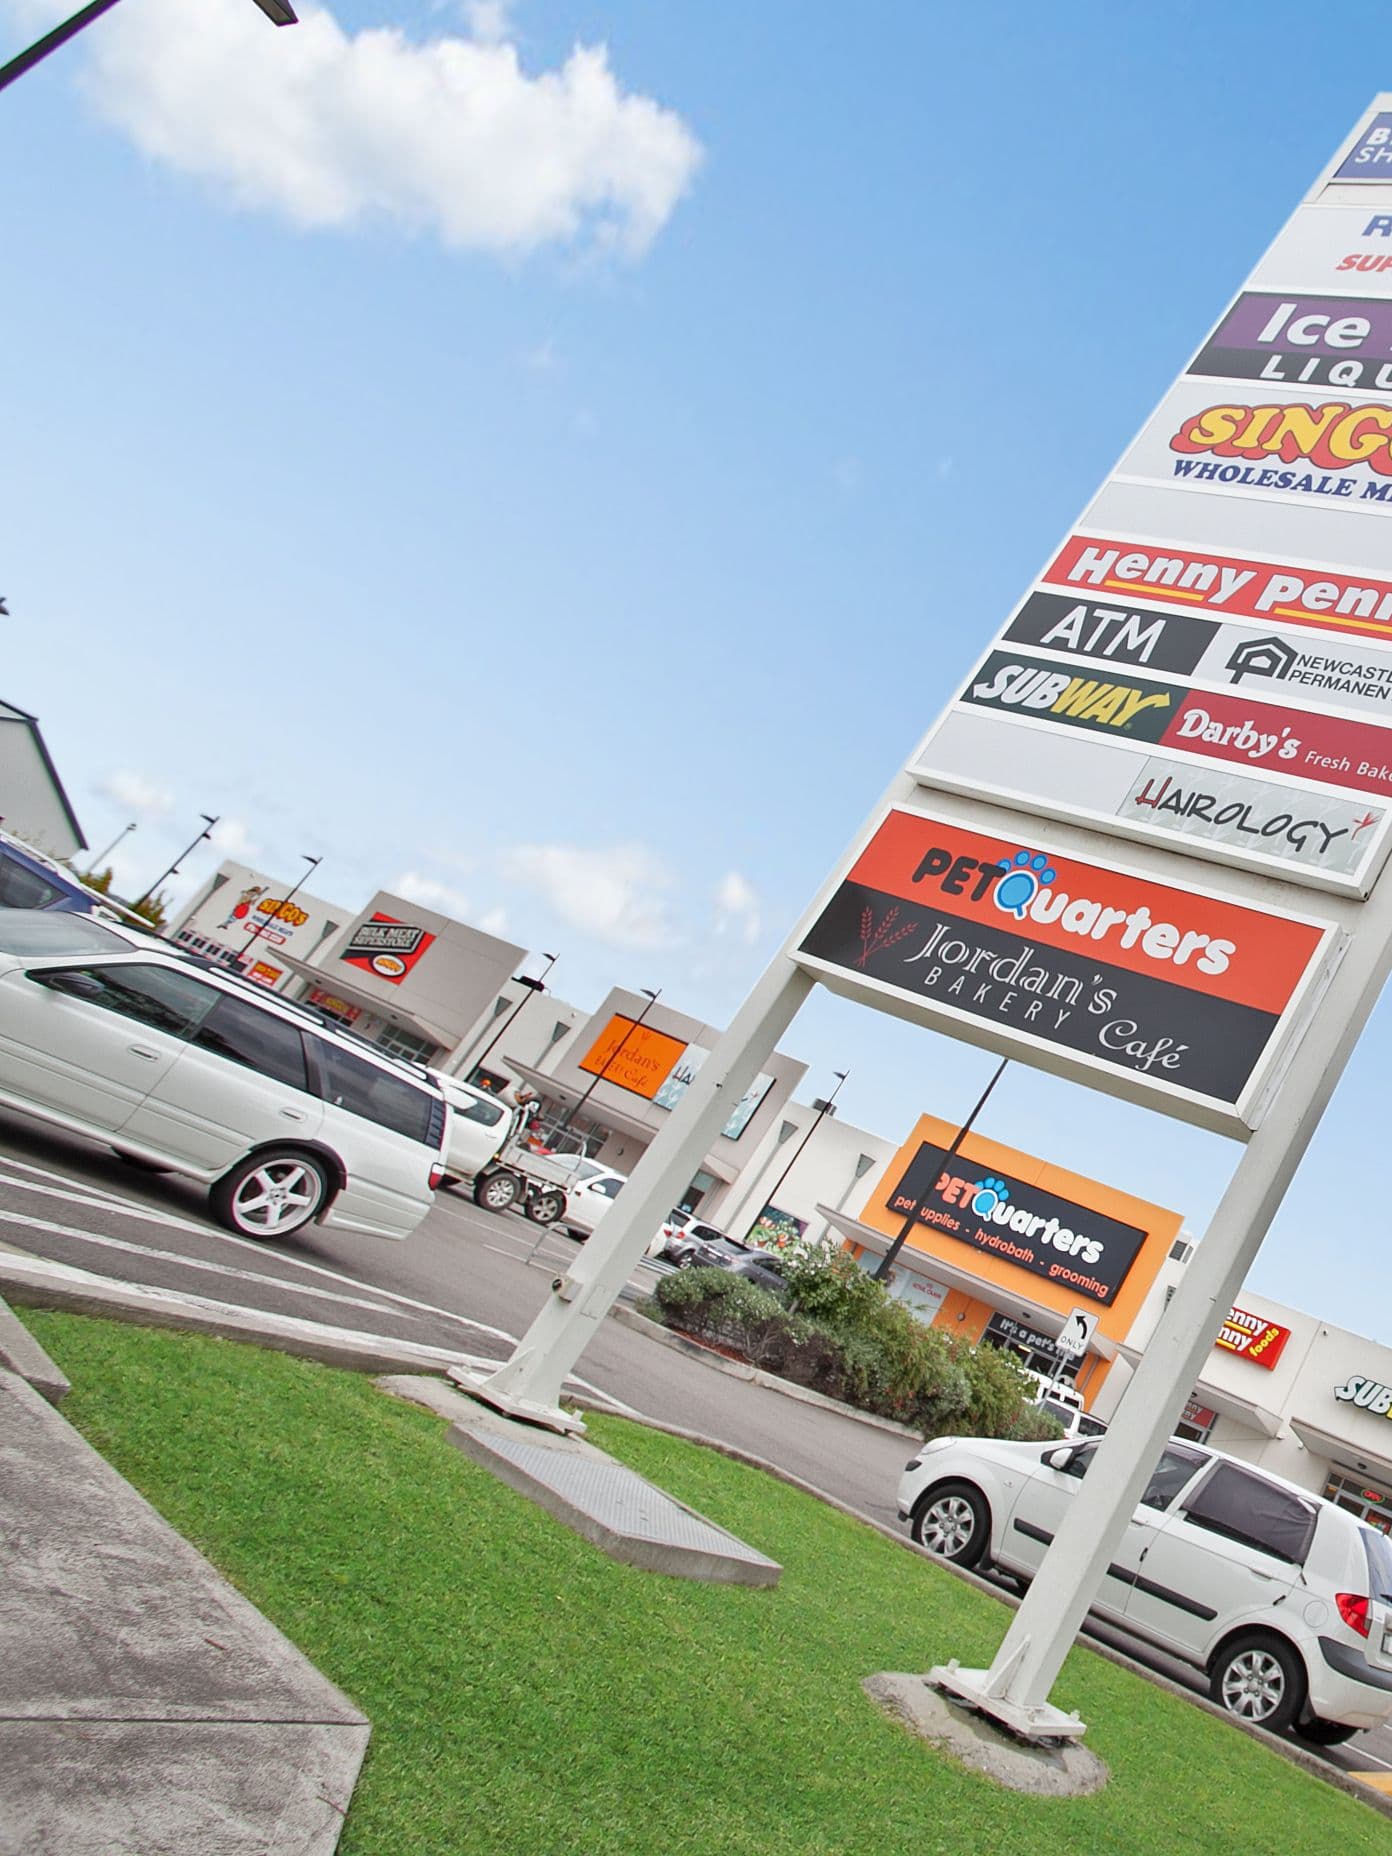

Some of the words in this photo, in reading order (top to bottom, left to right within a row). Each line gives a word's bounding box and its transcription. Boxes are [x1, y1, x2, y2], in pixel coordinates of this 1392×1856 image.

[1257, 303, 1371, 349] Ice
[1173, 459, 1357, 496] WHOLESALE
[1067, 546, 1257, 604] Henny
[1040, 605, 1166, 663] ATM
[973, 665, 1170, 727] SUBWAY
[1176, 709, 1302, 759] Darby's
[1304, 750, 1350, 772] Fresh
[1135, 777, 1348, 853] HAIROLOGY
[904, 923, 1117, 1014] Jordan's
[924, 966, 1071, 1029] BAKERY
[1099, 1019, 1190, 1071] Café
[894, 1195, 915, 1211] pet
[920, 1205, 961, 1231] upplies
[974, 1228, 1035, 1264] hydrobath
[1049, 1262, 1109, 1299] grooming
[1061, 1336, 1084, 1350] ONLY
[1217, 1326, 1253, 1351] nny
[1227, 1308, 1269, 1337] nny
[1249, 1327, 1279, 1357] foods
